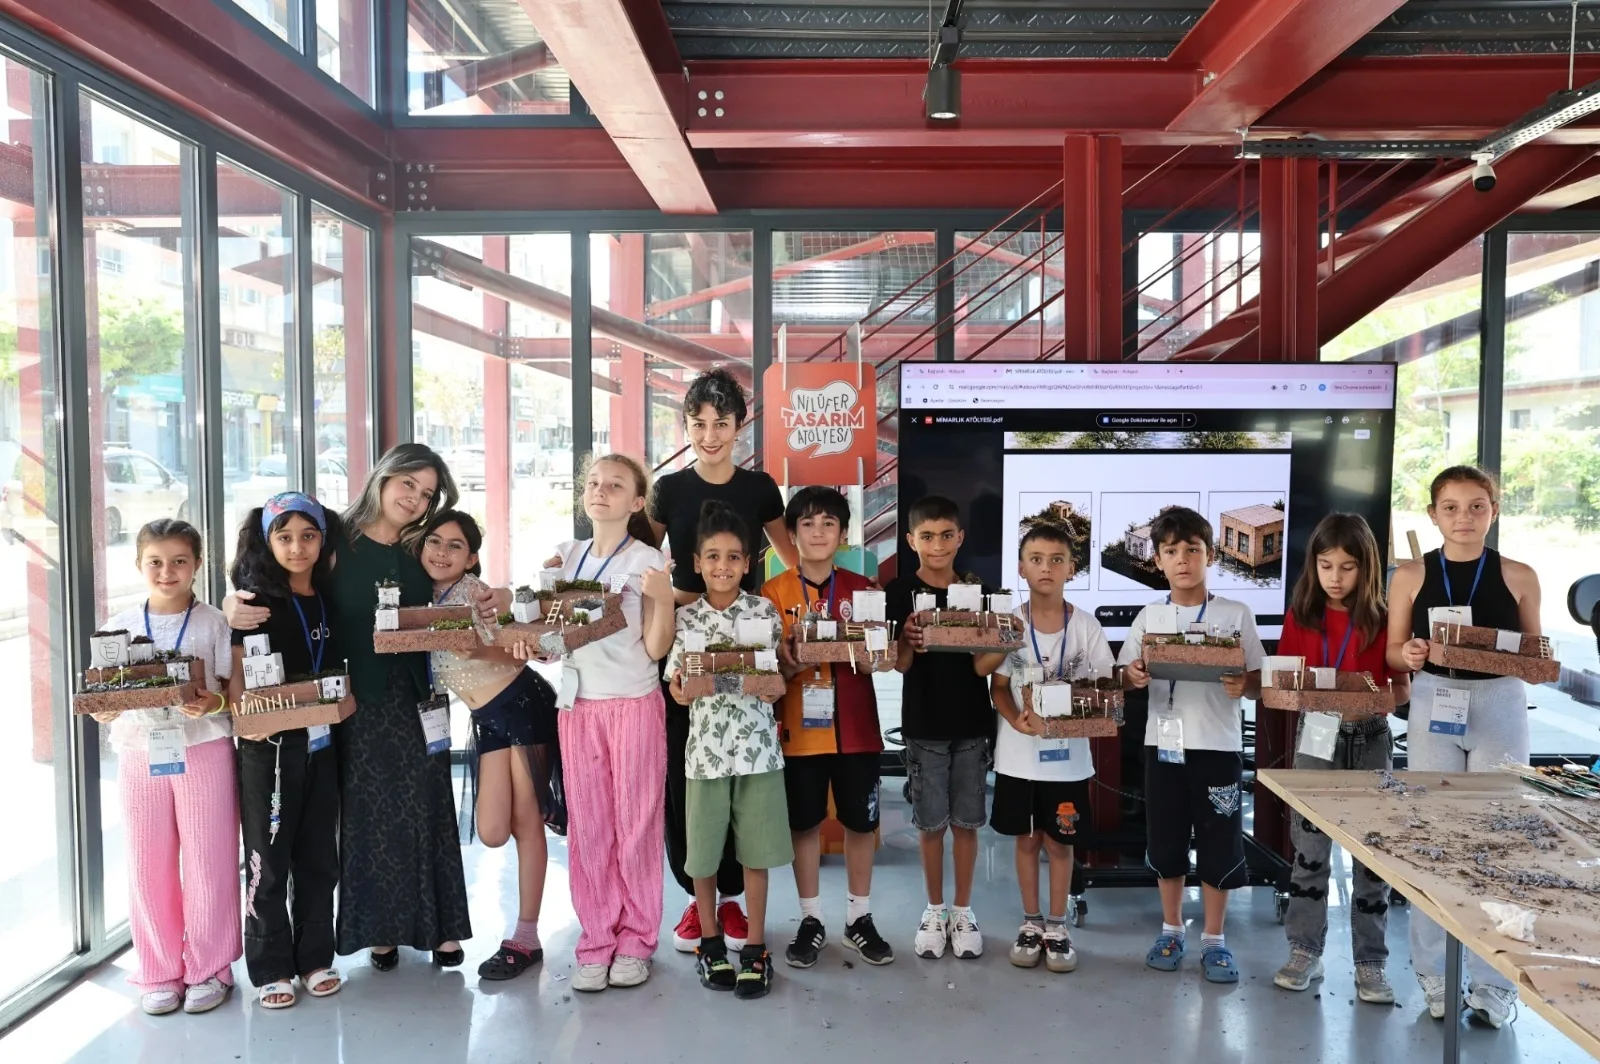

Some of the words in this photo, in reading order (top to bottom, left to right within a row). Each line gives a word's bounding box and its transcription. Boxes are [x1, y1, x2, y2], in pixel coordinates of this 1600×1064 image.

[797, 393, 849, 412] NİLÜFER
[781, 407, 865, 428] TASARIM
[1111, 416, 1129, 424] Google
[797, 427, 848, 445] ATÖLYESİ
